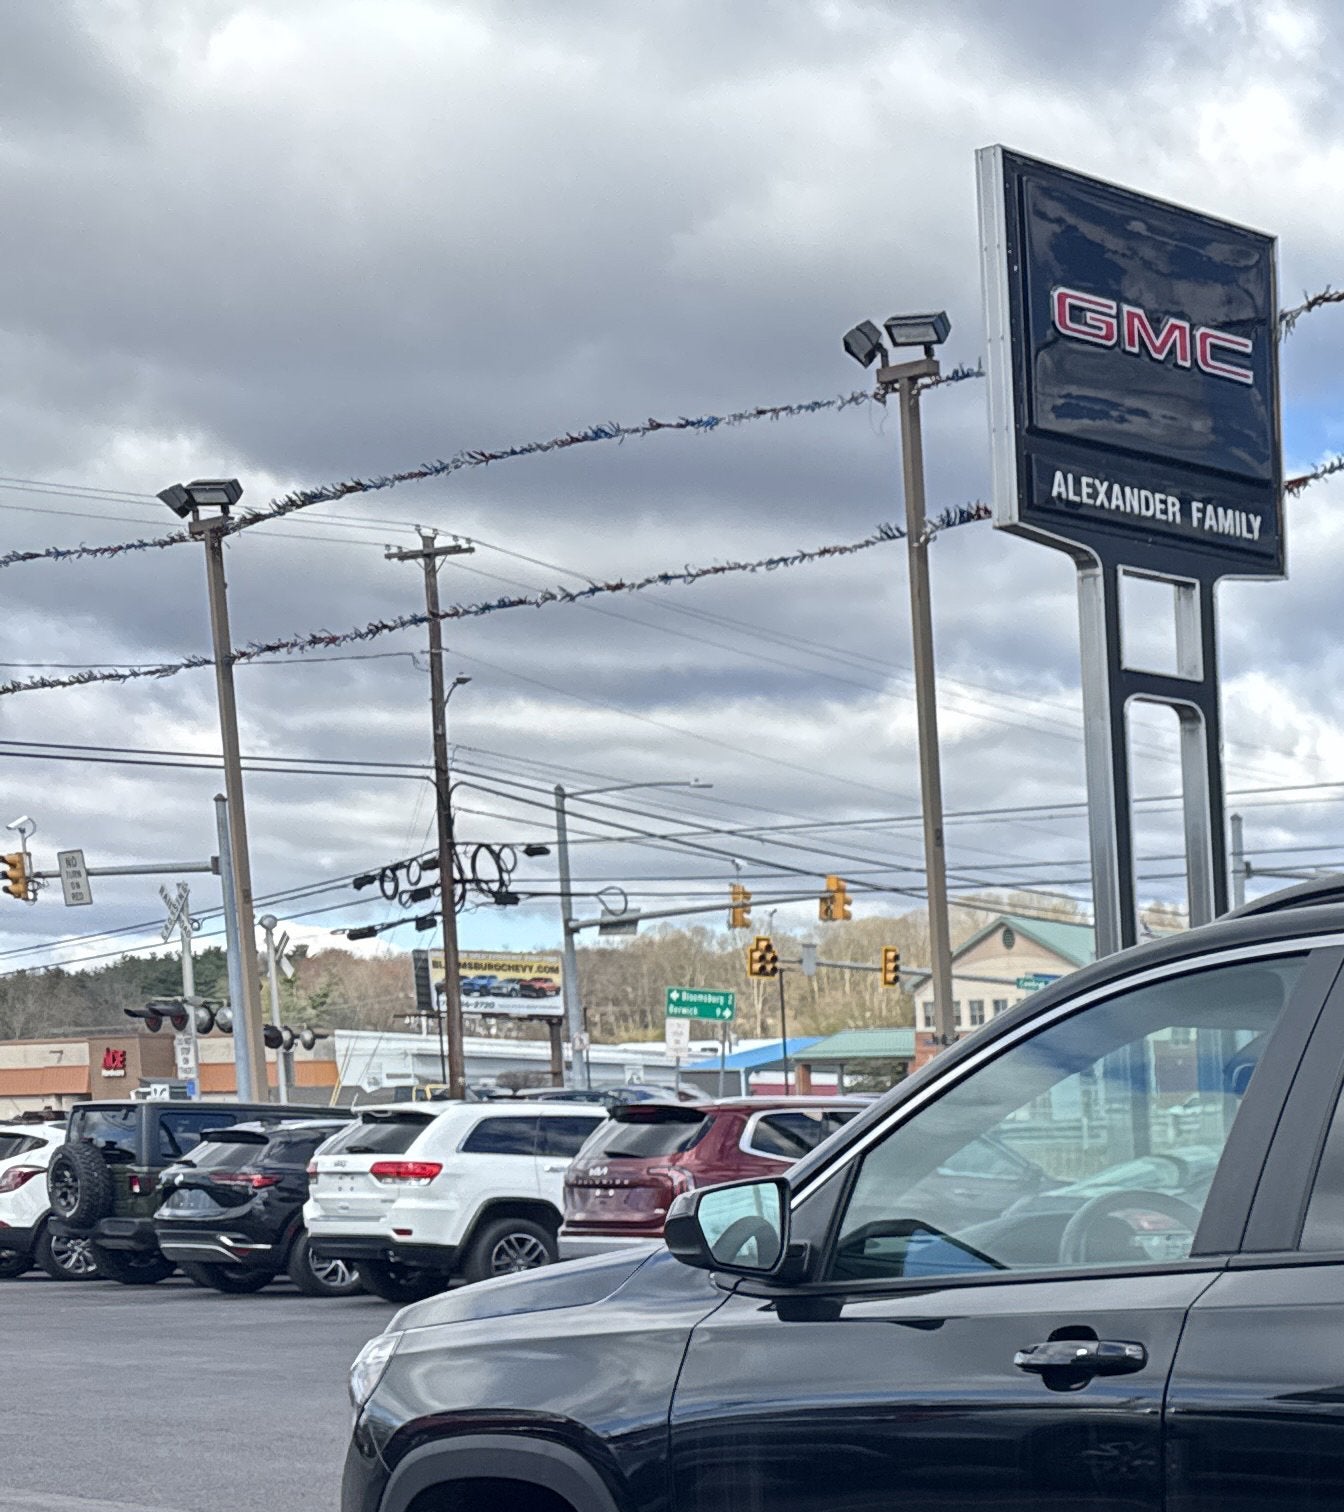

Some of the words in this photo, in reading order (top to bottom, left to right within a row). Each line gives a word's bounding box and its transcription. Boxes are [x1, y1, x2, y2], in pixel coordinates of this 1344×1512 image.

[1052, 287, 1254, 384] GMC
[1051, 470, 1182, 525] ALEXANDER
[1191, 501, 1263, 541] FAMILY
[65, 855, 77, 868] NO
[431, 960, 560, 975] BLMSBURGCHEVY.COM
[682, 991, 724, 1005] Bloomsburg
[669, 1003, 698, 1016] Berwick
